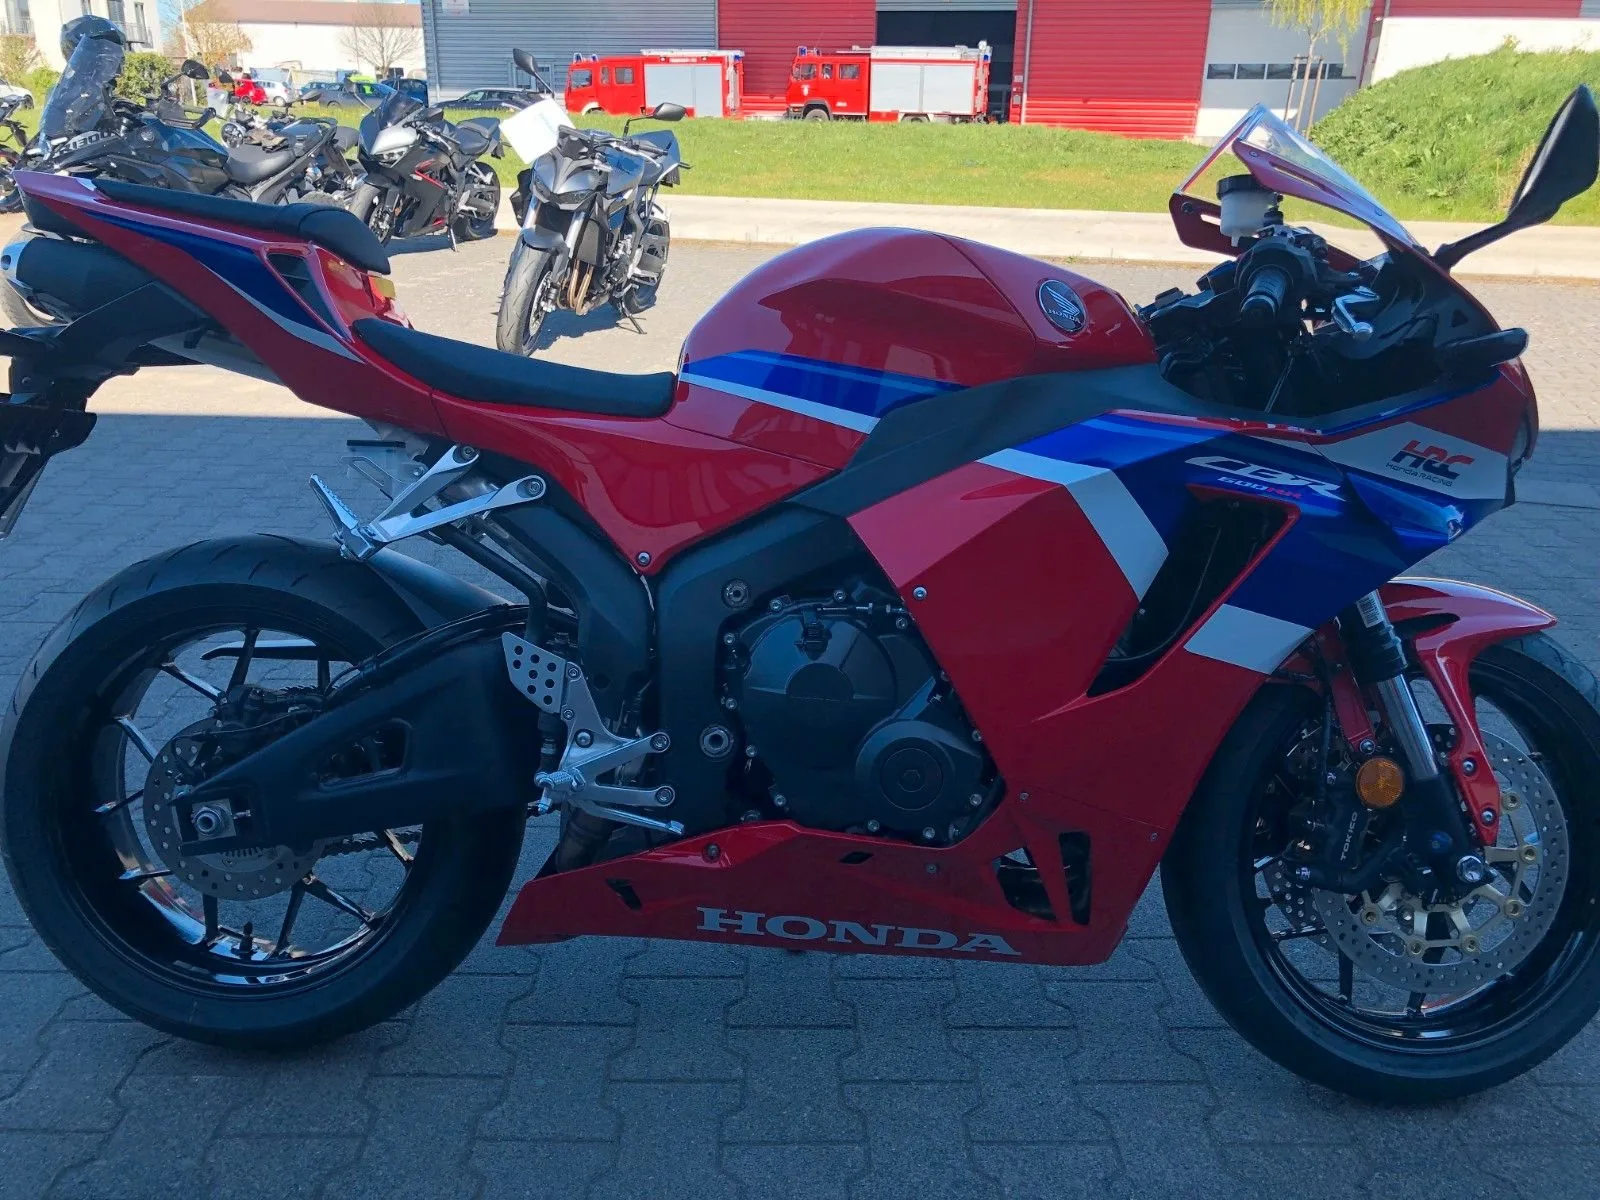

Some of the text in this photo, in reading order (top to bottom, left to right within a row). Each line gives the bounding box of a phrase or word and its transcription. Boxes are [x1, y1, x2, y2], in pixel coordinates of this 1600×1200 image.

[1047, 309, 1081, 324] HONDA
[1184, 456, 1346, 502] CBR
[1391, 439, 1476, 480] HRC
[1419, 472, 1453, 487] RACING
[1340, 811, 1358, 861] TOKICO
[696, 906, 1022, 956] HONDA
